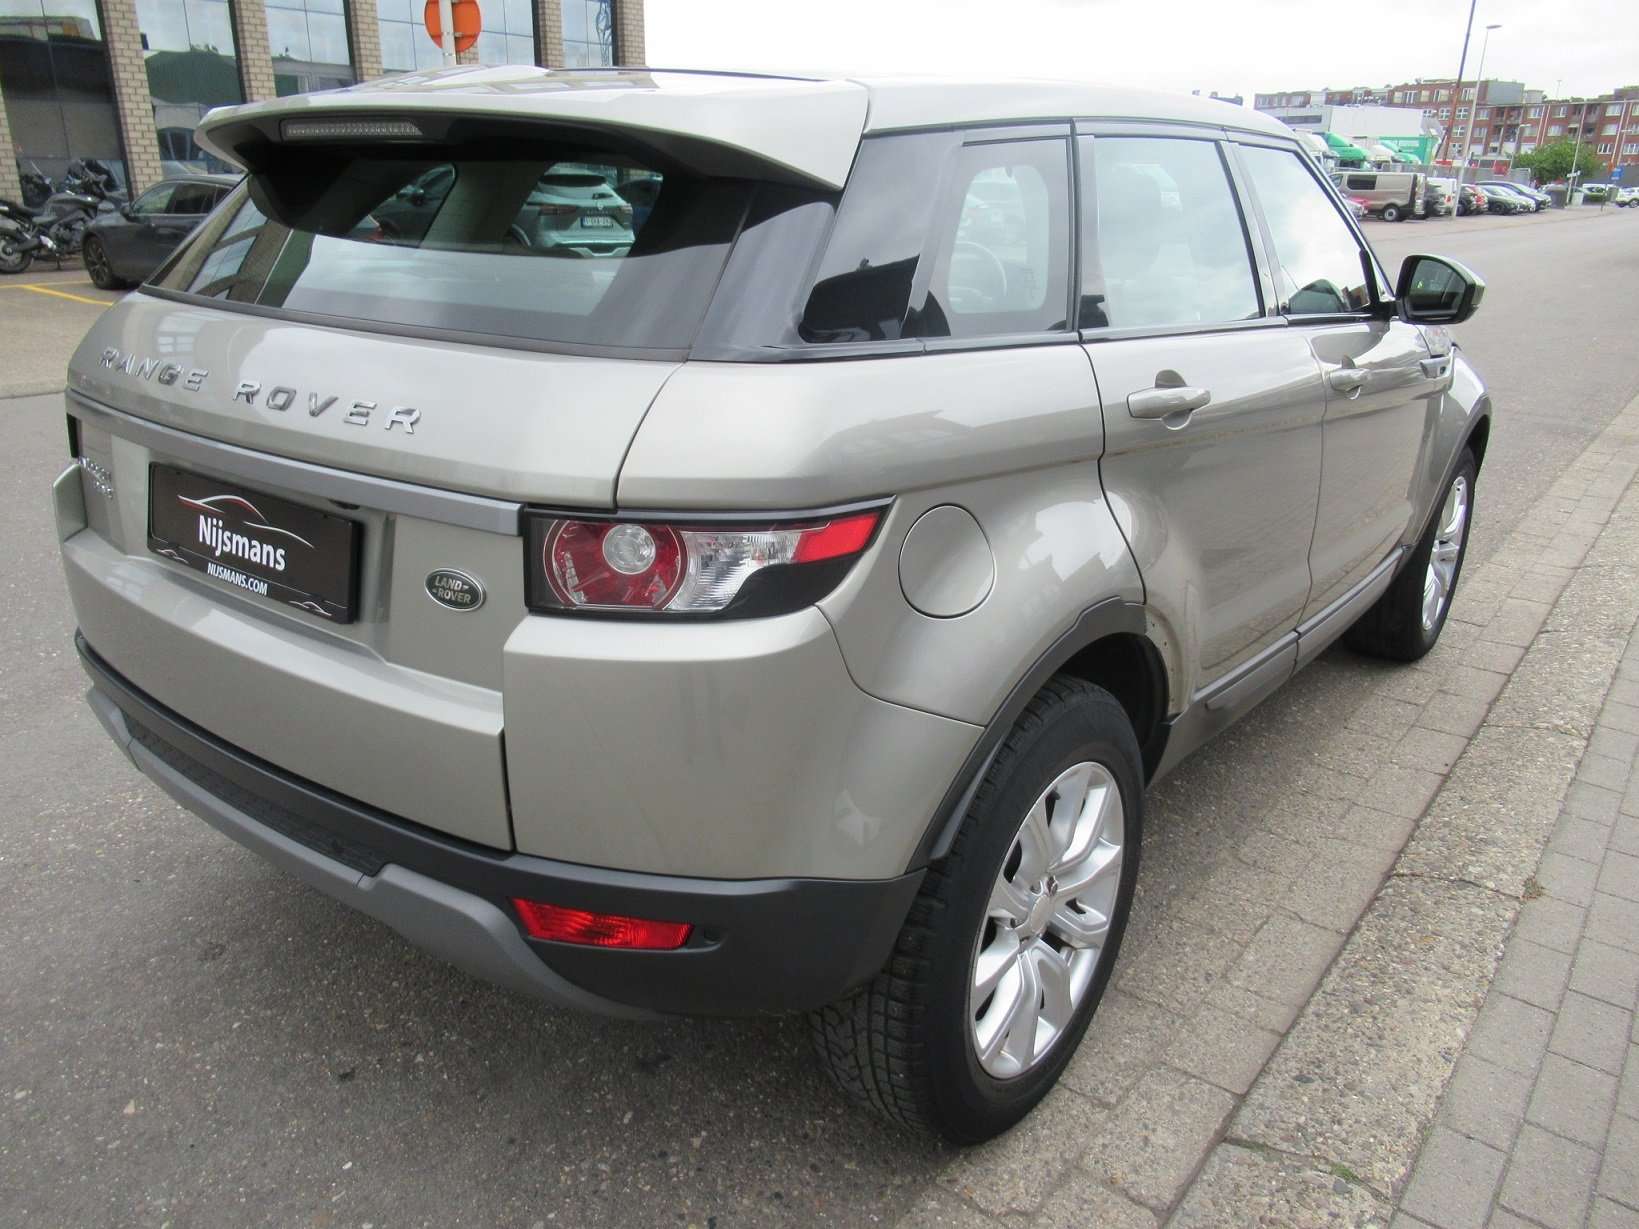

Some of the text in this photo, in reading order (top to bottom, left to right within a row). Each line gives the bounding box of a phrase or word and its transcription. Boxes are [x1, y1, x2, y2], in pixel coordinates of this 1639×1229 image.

[99, 346, 422, 434] RANGE ROVER
[198, 515, 286, 571] Nijsmans
[207, 562, 268, 596] NIJSMANS.COM
